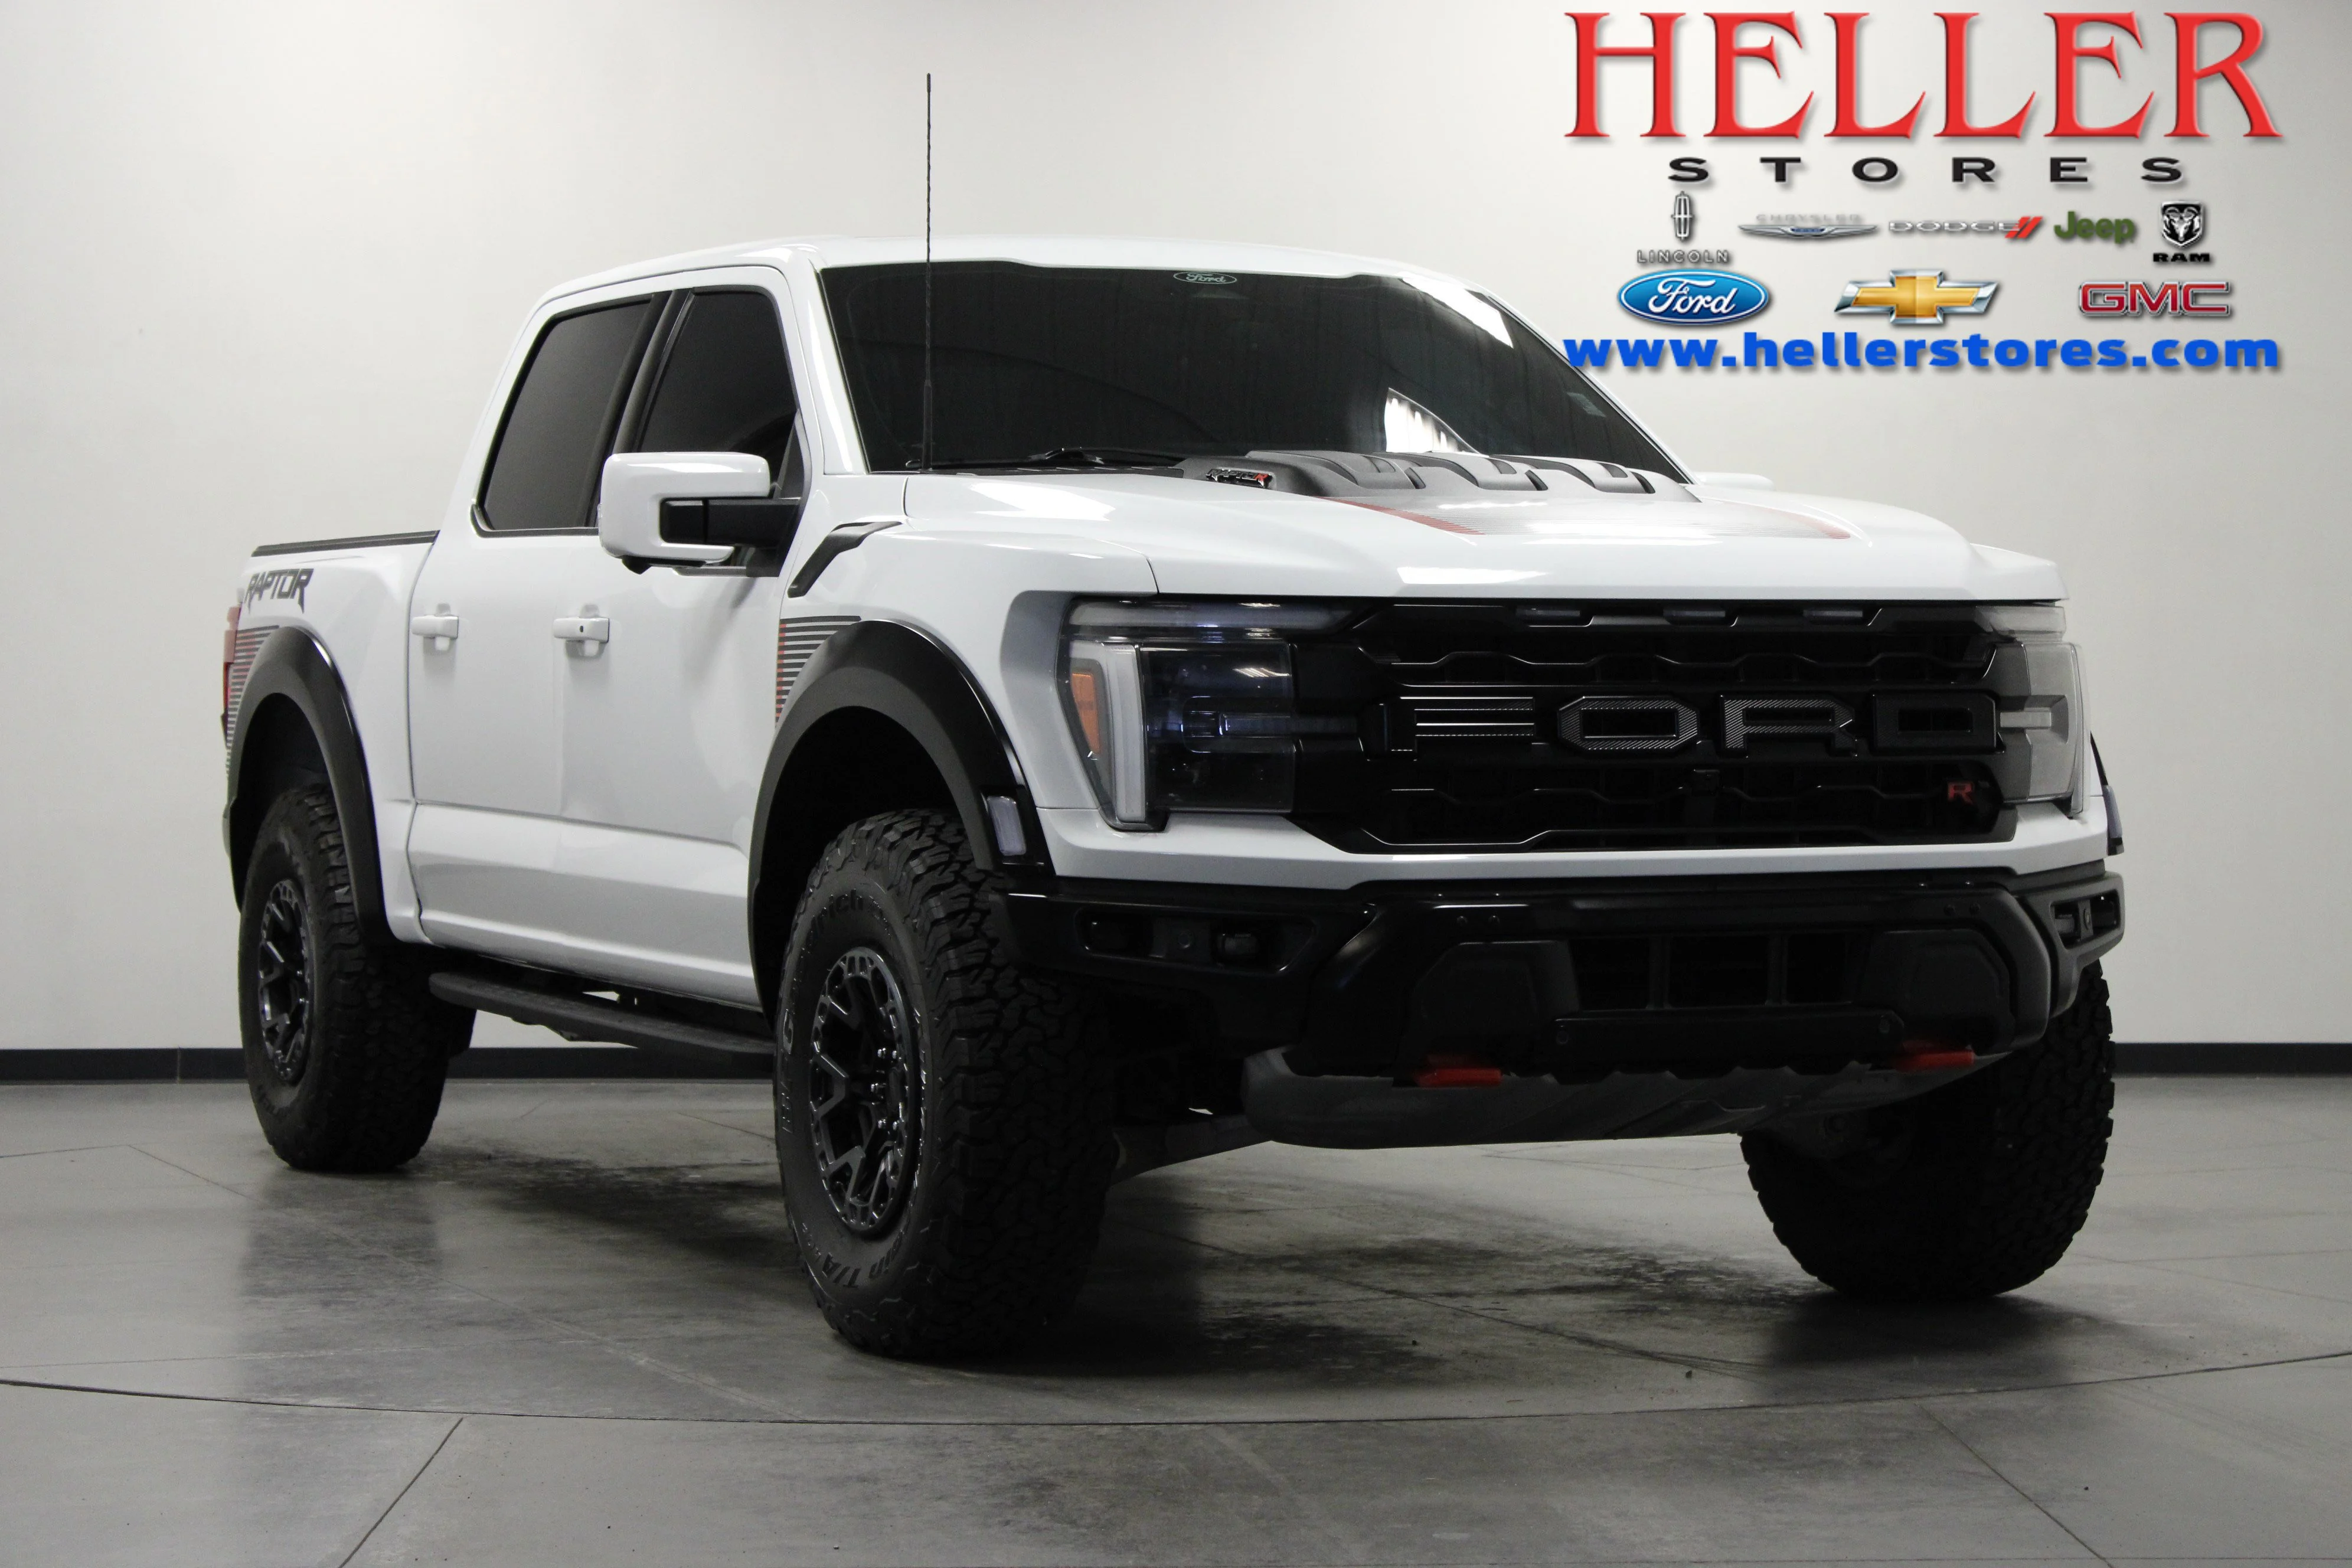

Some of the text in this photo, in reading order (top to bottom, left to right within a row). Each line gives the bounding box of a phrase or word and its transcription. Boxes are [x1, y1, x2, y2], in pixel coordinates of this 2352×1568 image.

[1185, 273, 1226, 282] Ford
[244, 568, 314, 615] RAPTOR
[1367, 694, 1998, 757] FORD
[1948, 781, 1975, 805] R
